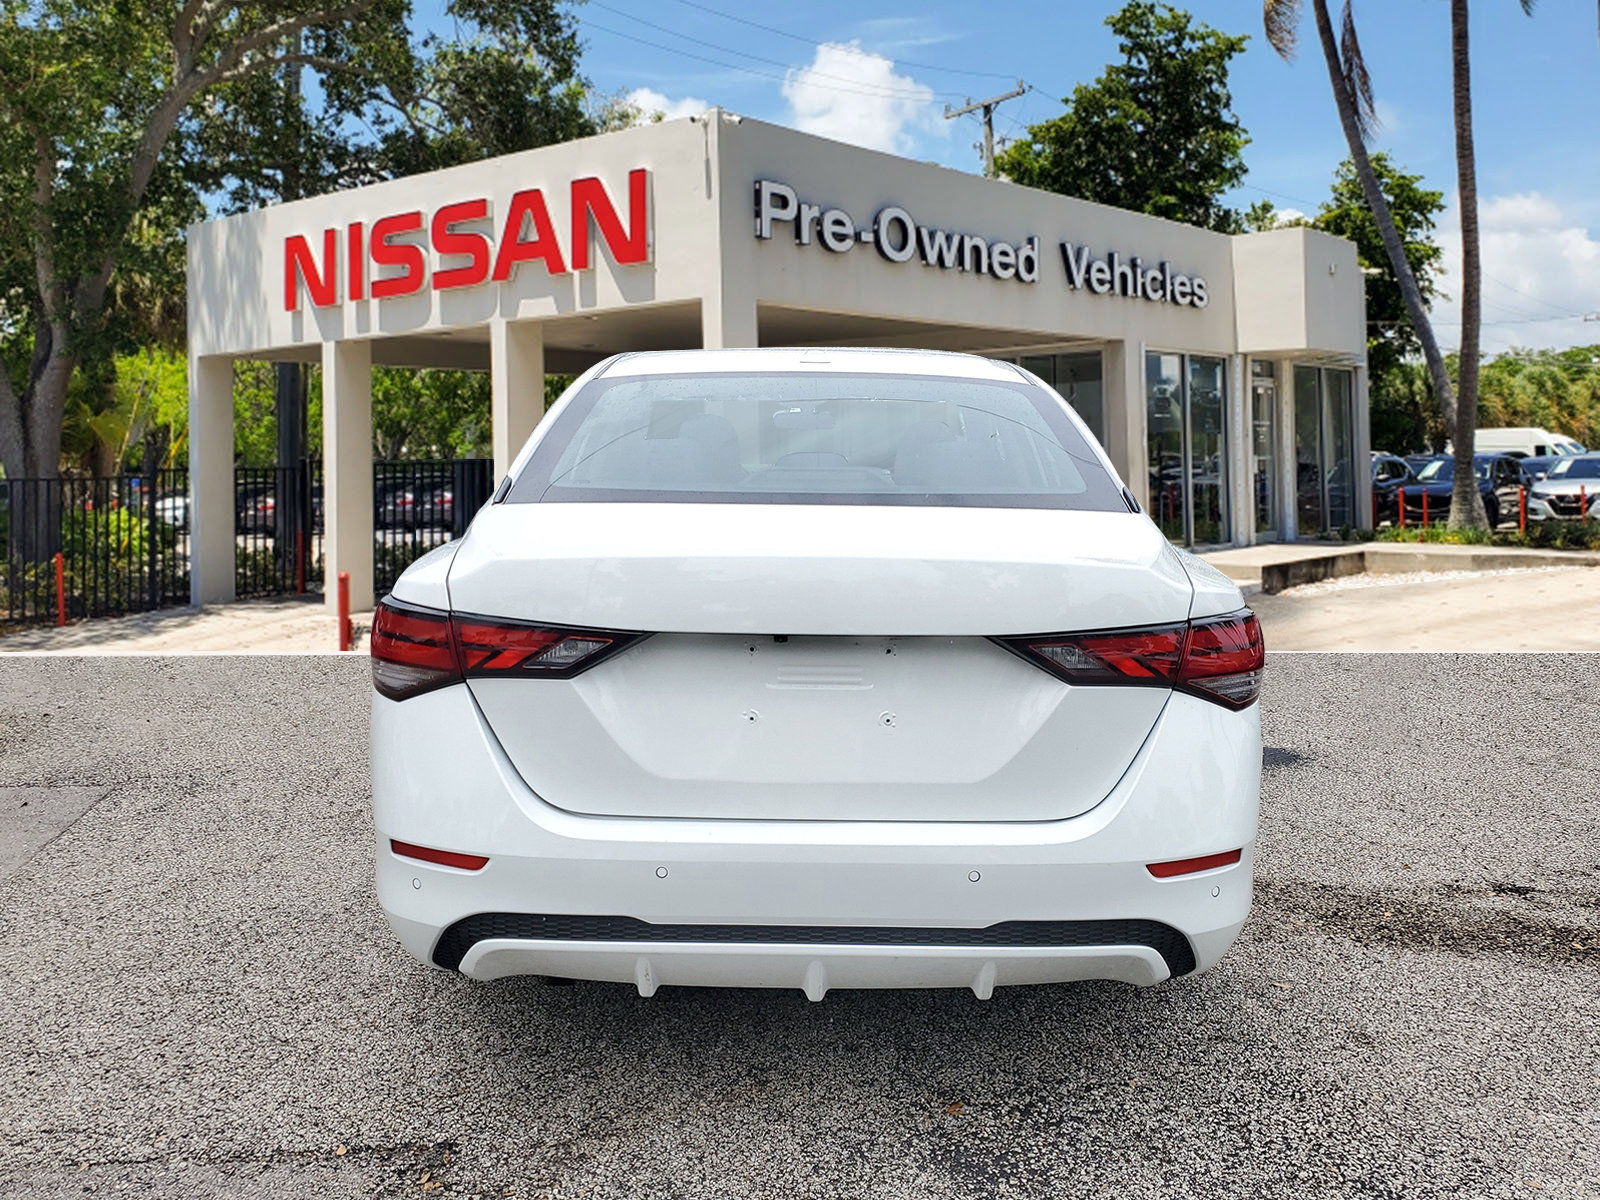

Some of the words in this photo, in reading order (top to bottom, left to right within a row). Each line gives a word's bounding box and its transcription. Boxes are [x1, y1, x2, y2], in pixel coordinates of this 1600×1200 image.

[284, 168, 647, 312] NISSAN
[755, 180, 1040, 283] Pre-Owned
[1060, 241, 1208, 308] Vehicles
